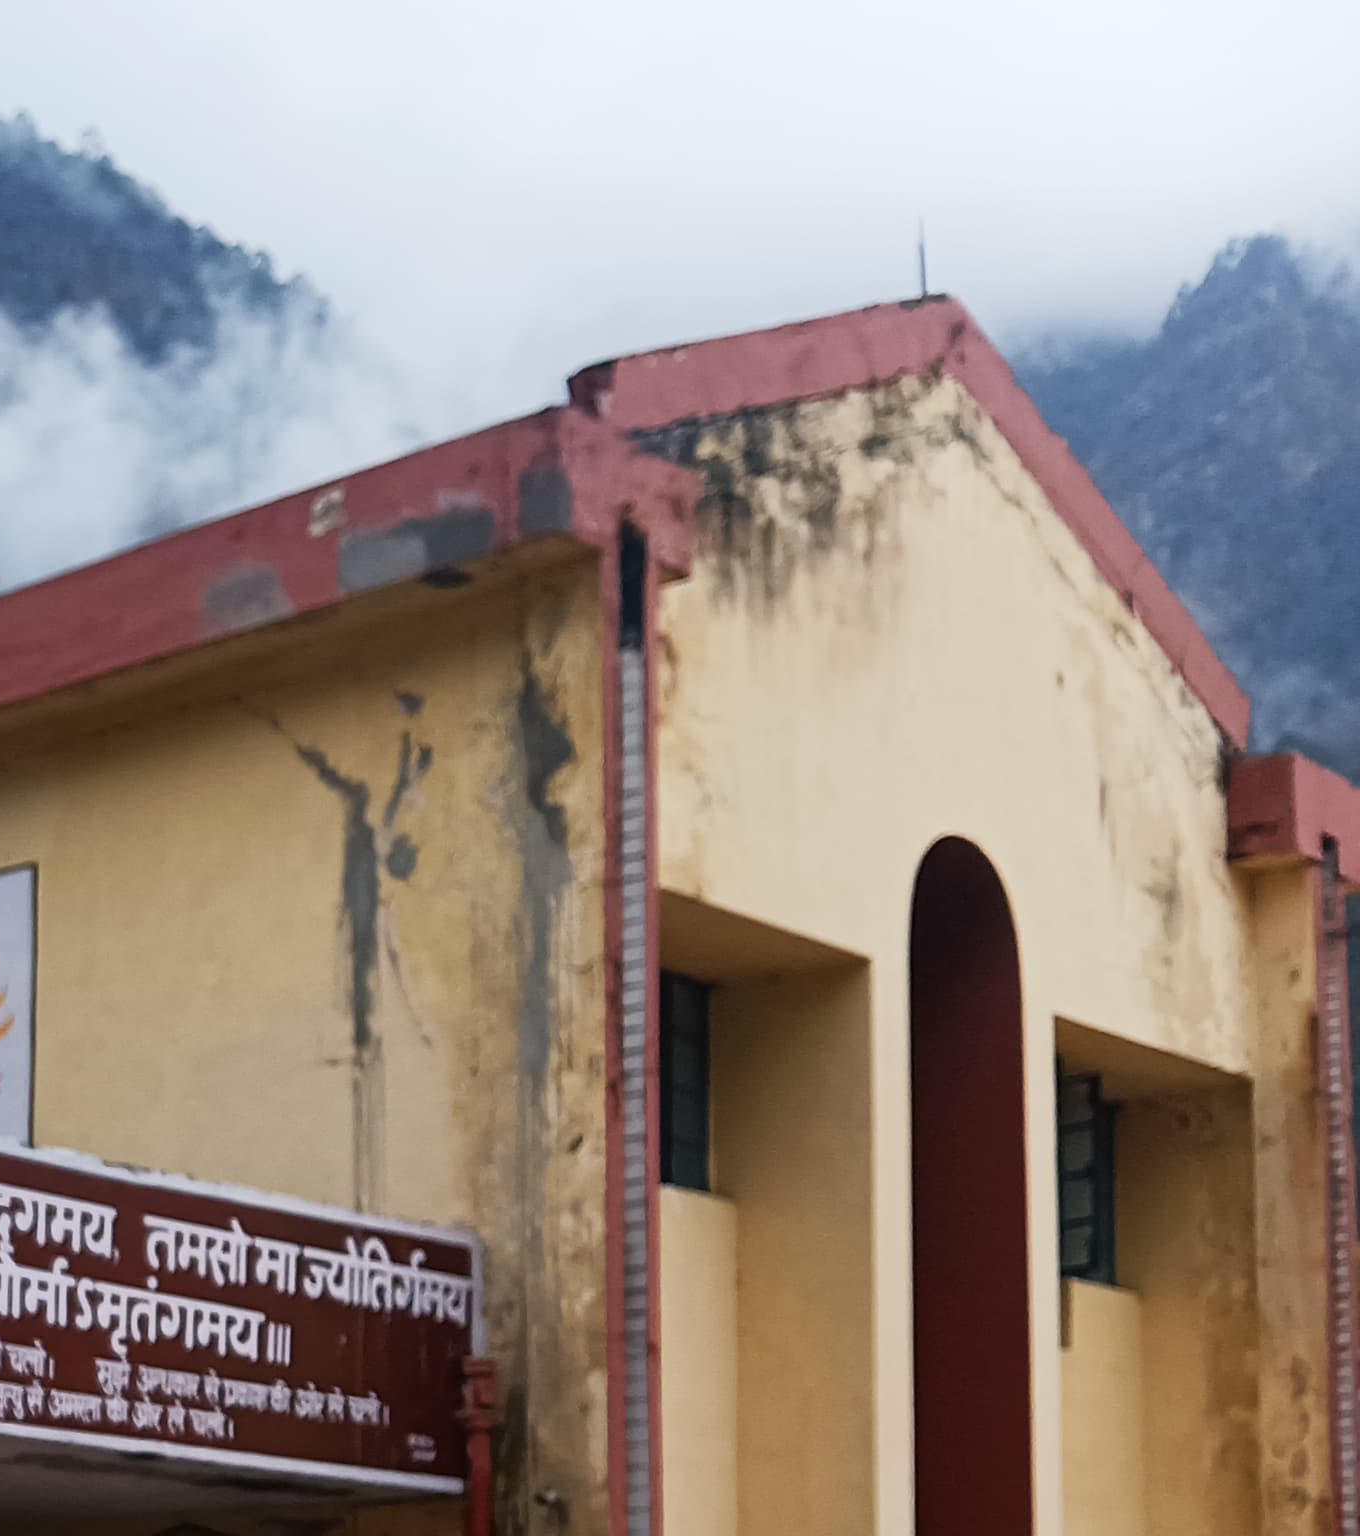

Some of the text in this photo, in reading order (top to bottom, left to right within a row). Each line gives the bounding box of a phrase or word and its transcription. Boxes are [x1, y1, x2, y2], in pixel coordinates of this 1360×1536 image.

[142, 1215, 253, 1287] तमसो
[254, 1238, 301, 1296] मा
[302, 1235, 472, 1327] ज्योतिर्गमय
